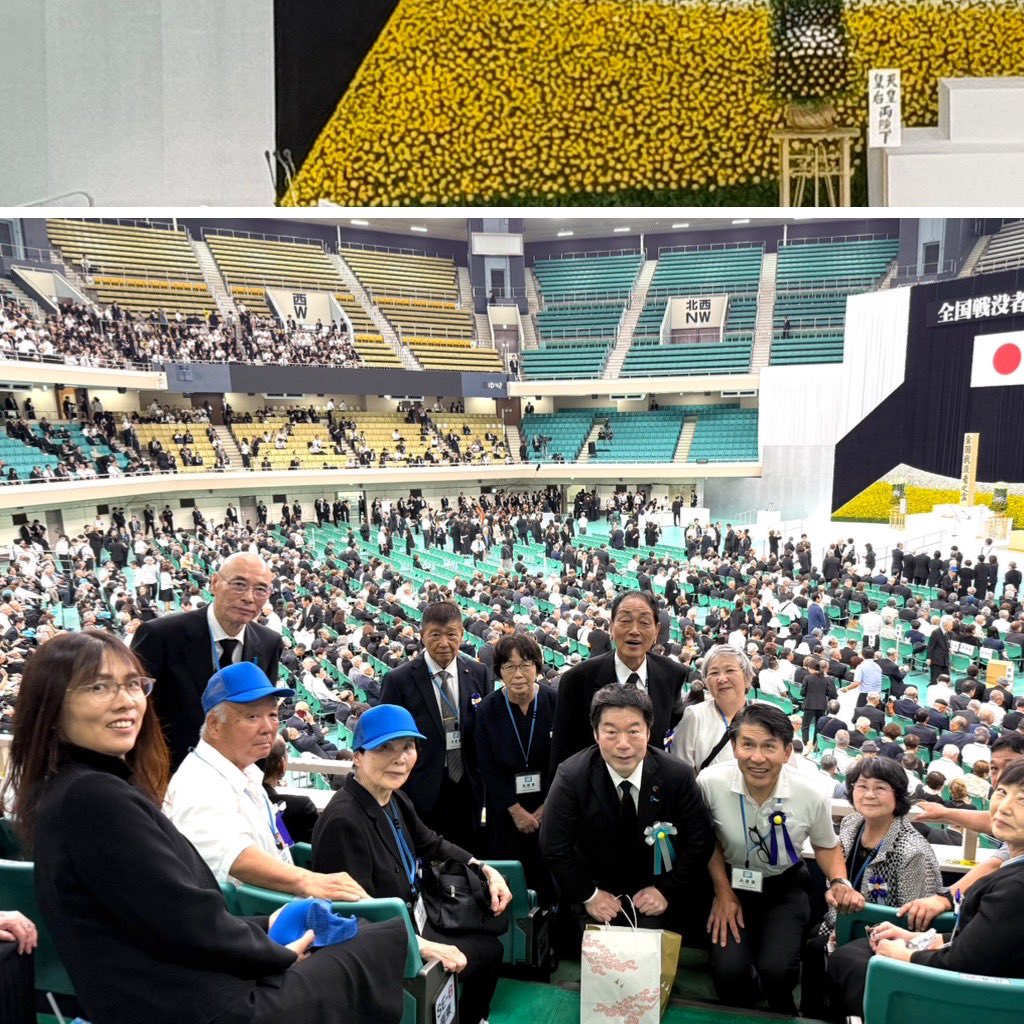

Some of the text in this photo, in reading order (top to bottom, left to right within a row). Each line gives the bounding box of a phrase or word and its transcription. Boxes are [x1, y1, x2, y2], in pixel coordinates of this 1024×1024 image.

[292, 292, 307, 306] 西
[685, 298, 712, 311] 北西
[293, 305, 308, 319] W
[685, 310, 711, 324] NW
